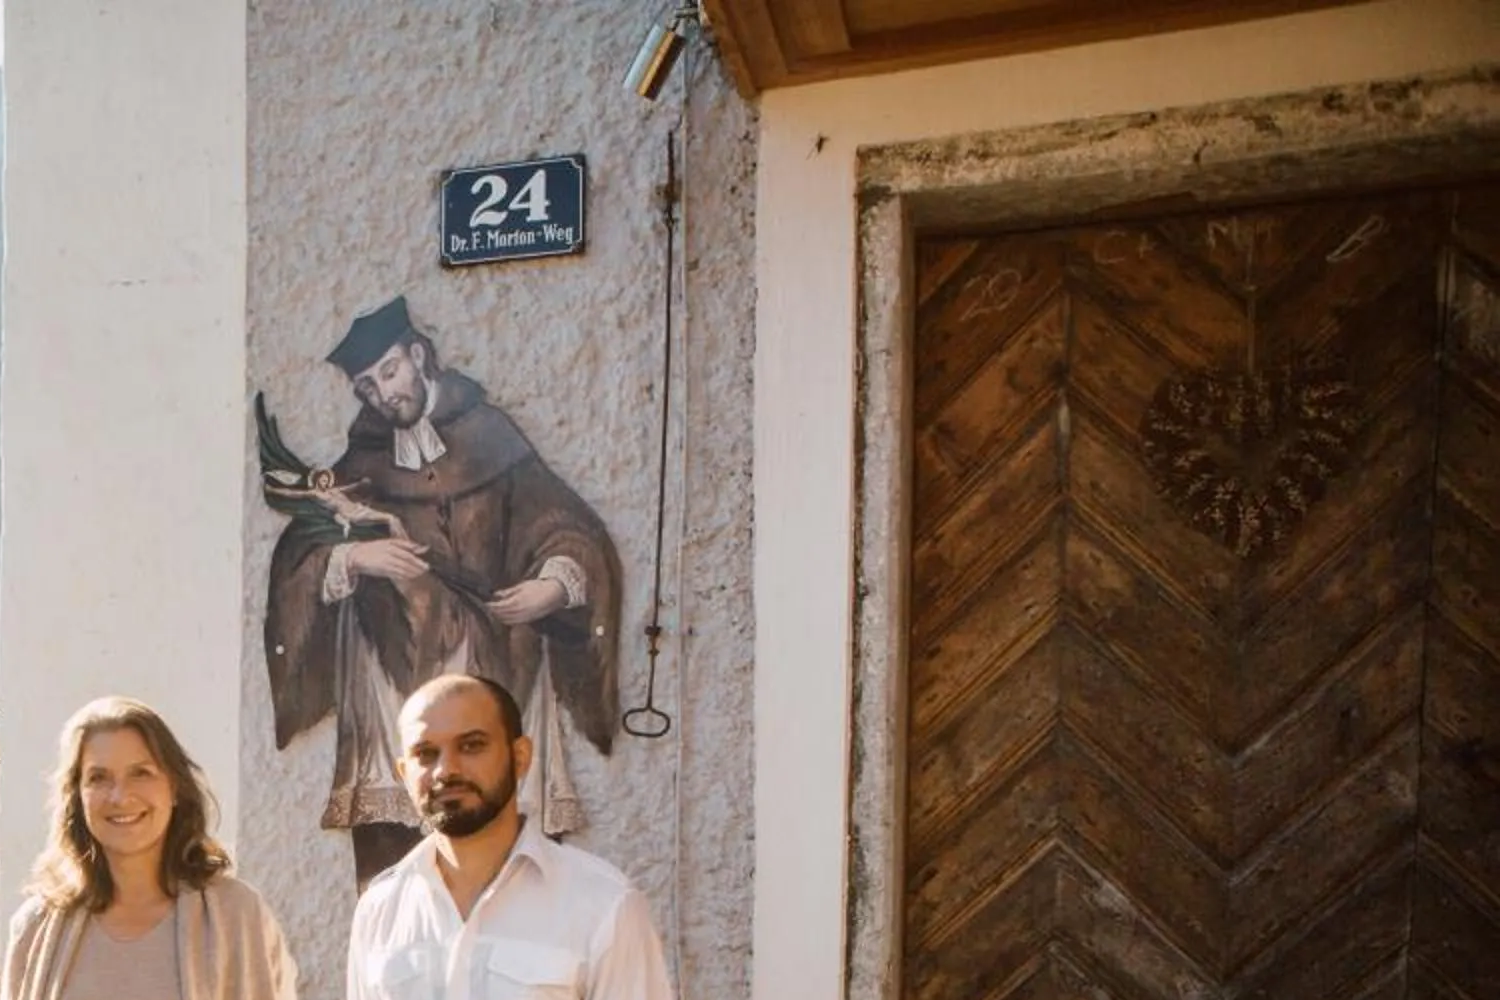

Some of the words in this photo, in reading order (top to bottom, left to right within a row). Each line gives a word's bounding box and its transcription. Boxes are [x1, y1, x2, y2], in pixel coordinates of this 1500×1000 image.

[469, 169, 551, 227] 24
[451, 234, 469, 252] Dr.
[472, 231, 485, 251] F.
